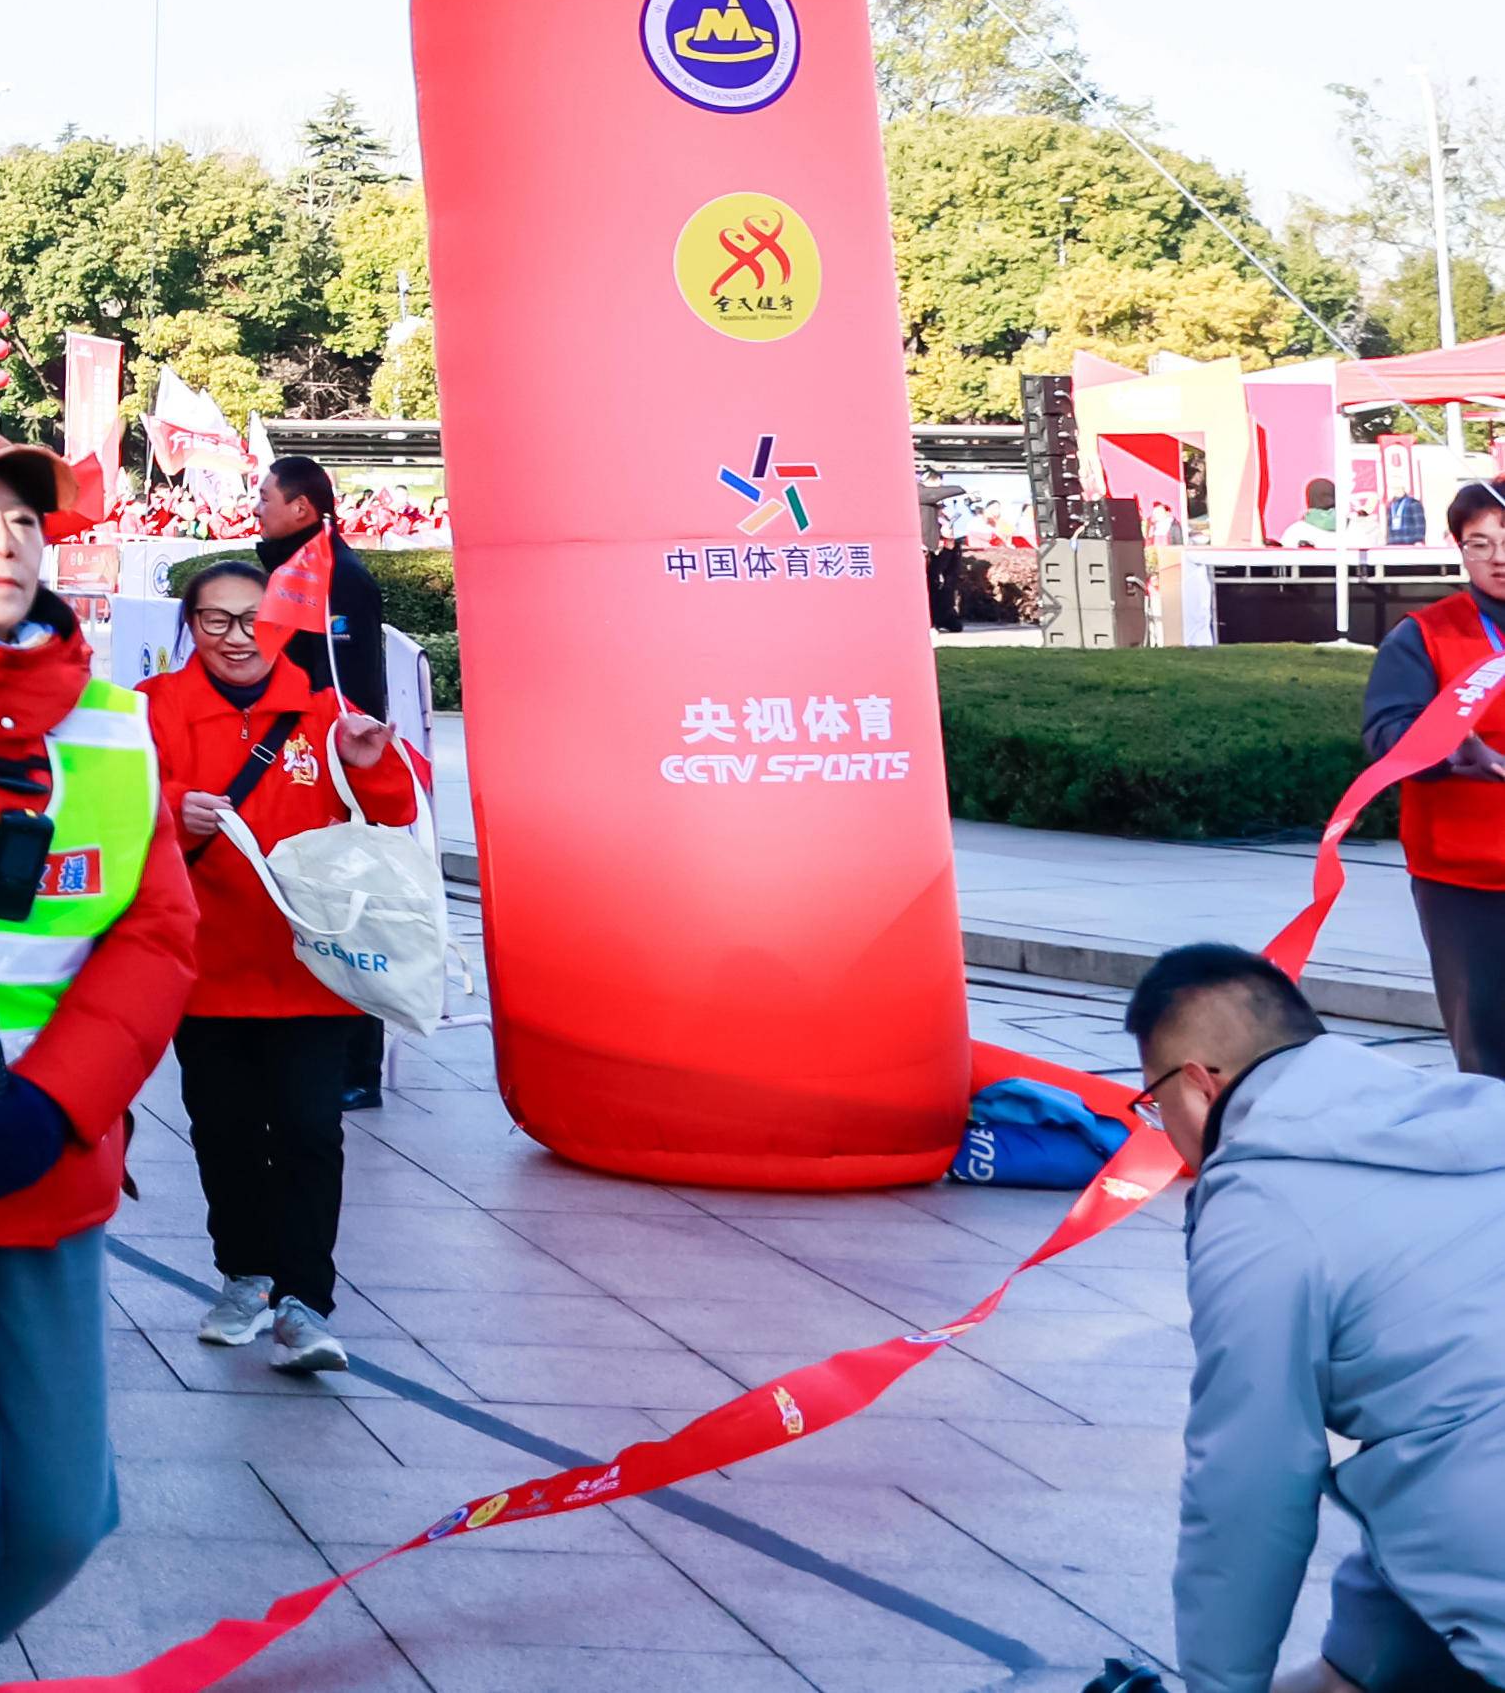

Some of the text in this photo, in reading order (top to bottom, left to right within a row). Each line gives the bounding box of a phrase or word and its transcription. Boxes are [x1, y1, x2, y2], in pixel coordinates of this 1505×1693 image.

[713, 294, 794, 312] 全民健身
[666, 545, 873, 581] 中国体育彩票
[681, 694, 893, 744] 央视体育
[660, 751, 910, 783] CCTV SPORTS
